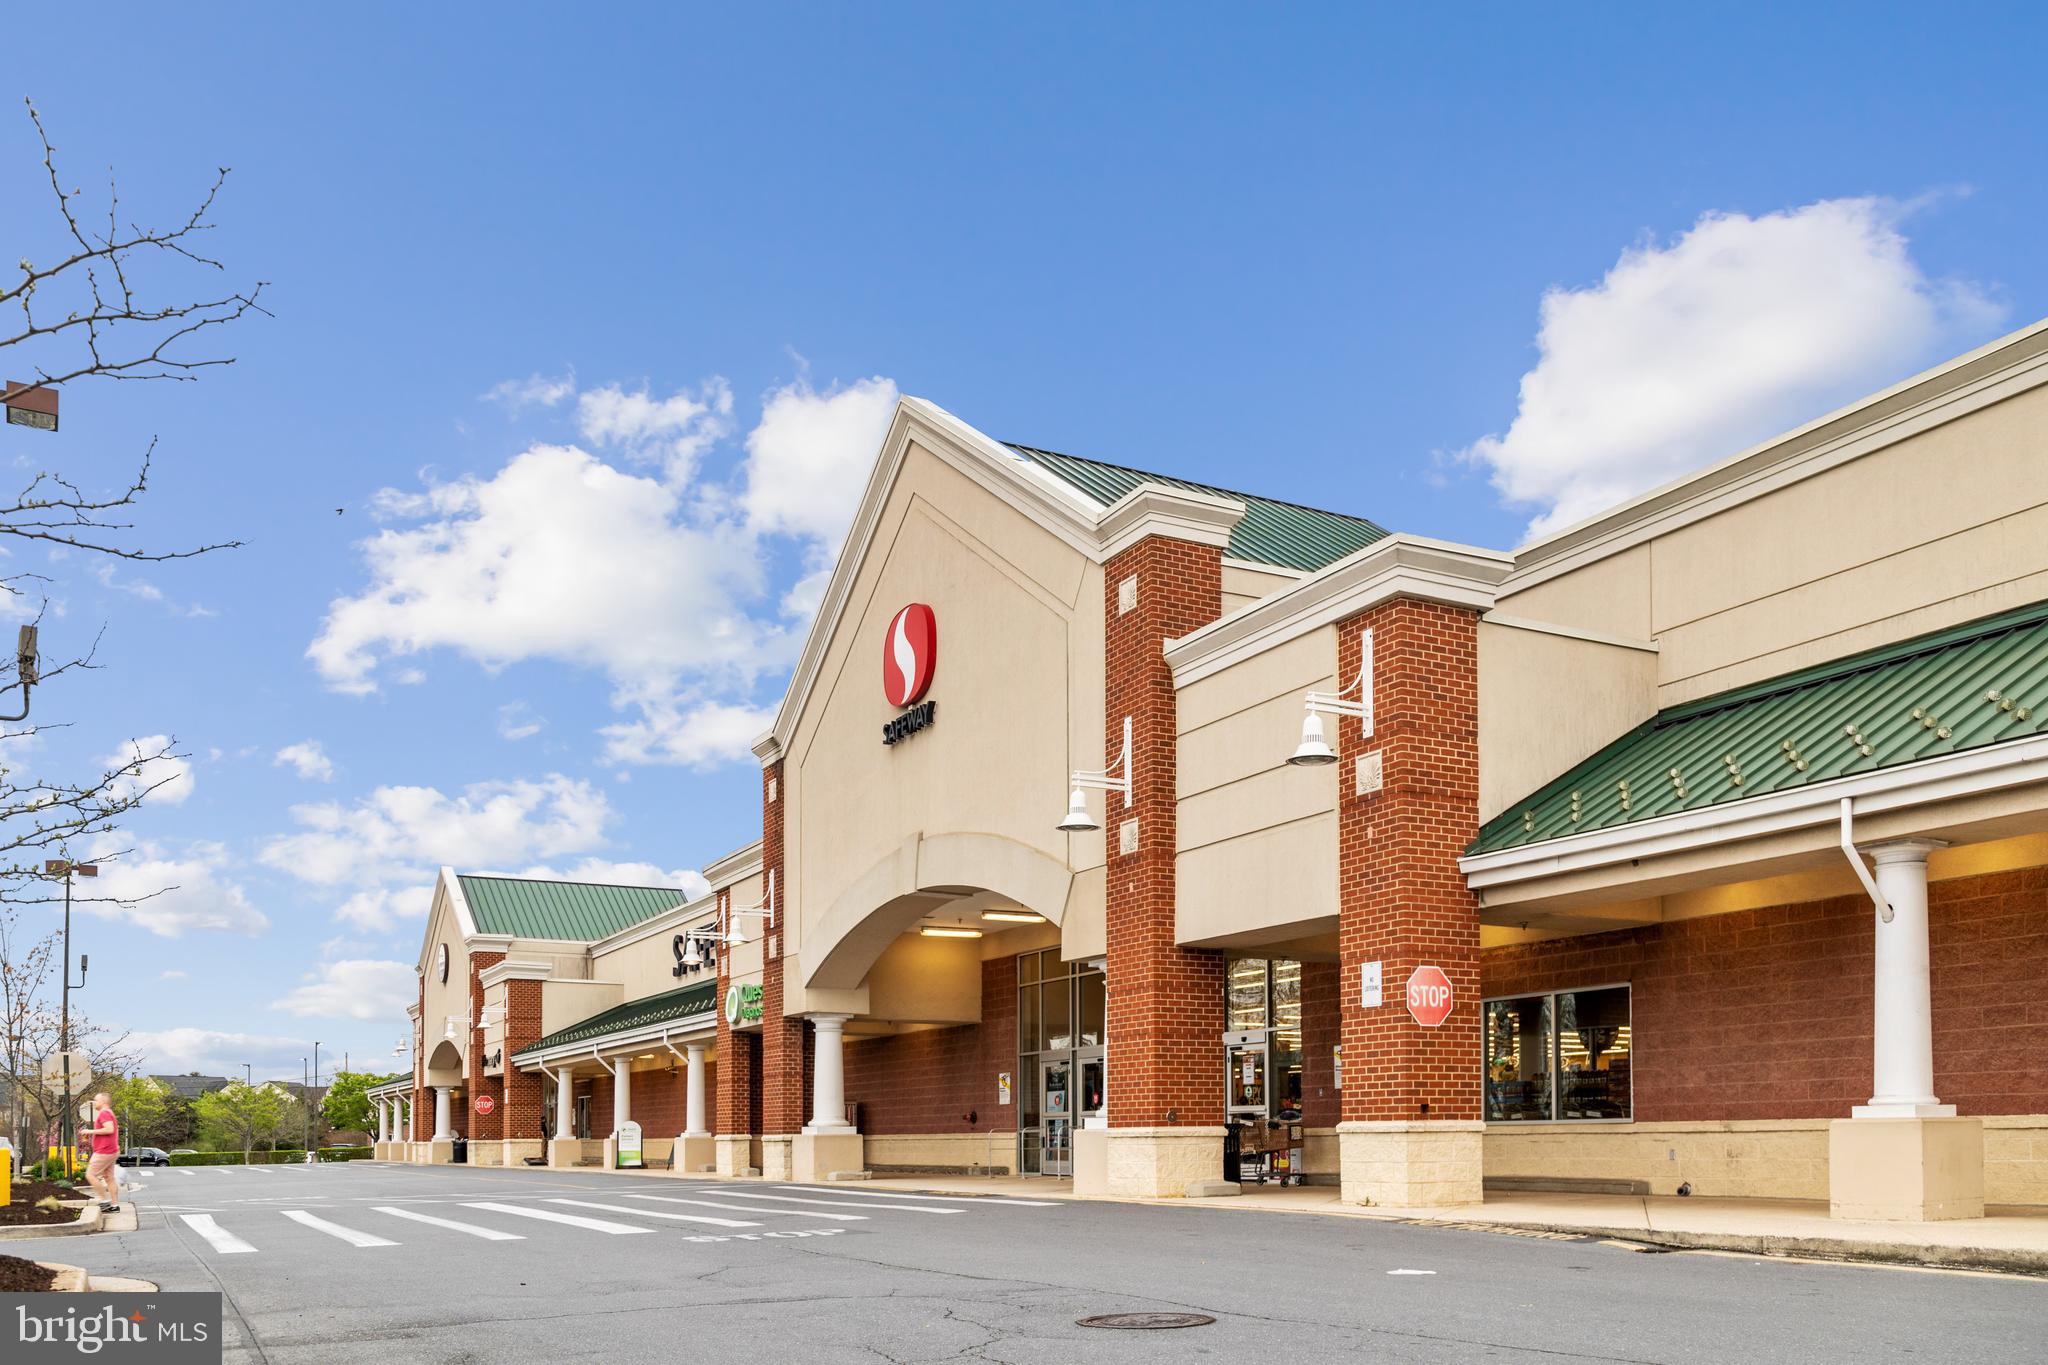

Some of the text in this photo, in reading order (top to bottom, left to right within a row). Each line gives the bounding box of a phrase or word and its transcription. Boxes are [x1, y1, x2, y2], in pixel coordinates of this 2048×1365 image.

[883, 701, 937, 745] SAFEWAY
[1410, 985, 1449, 1007] STOP
[476, 1101, 493, 1109] STOP
